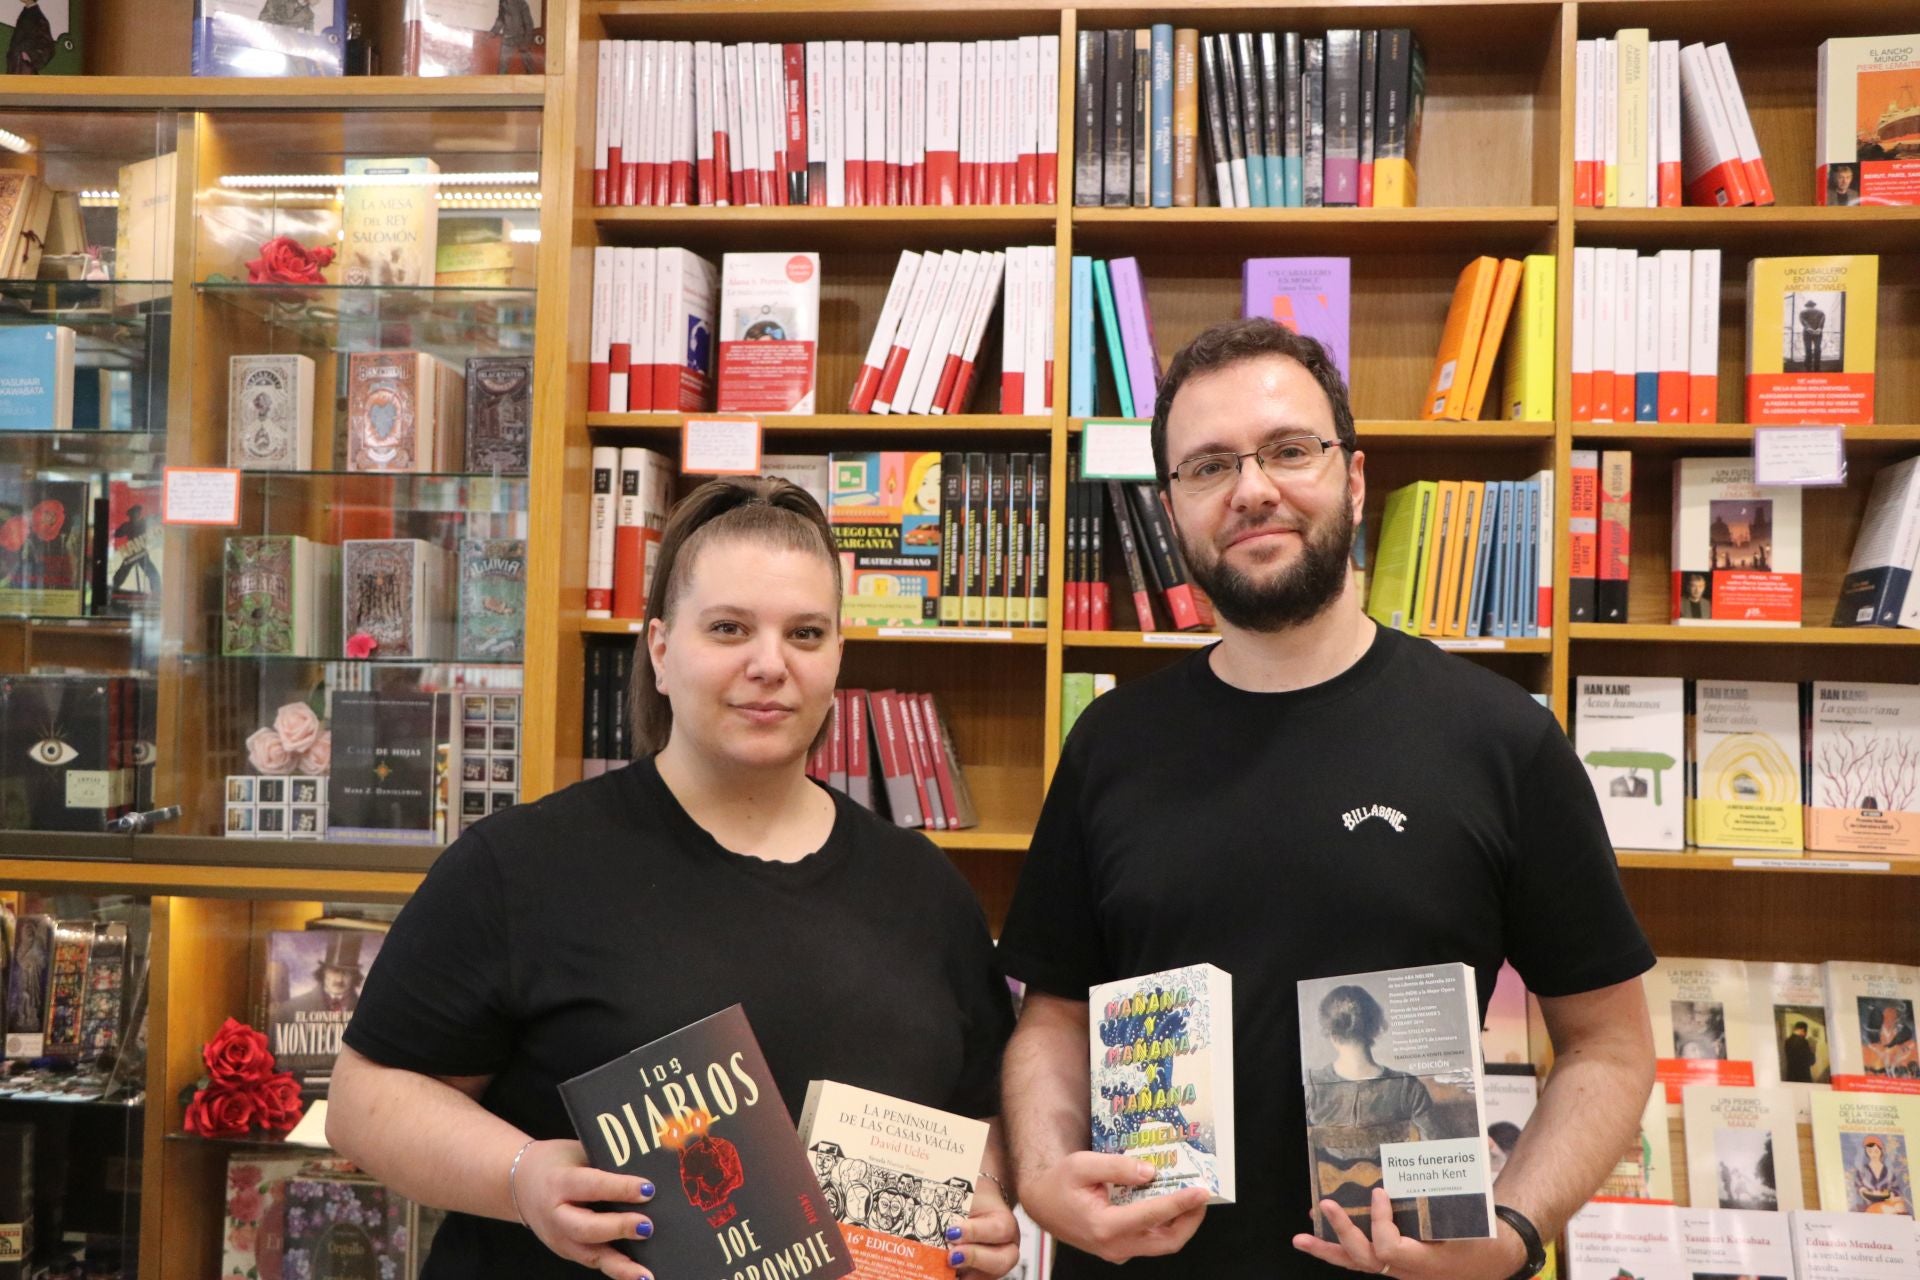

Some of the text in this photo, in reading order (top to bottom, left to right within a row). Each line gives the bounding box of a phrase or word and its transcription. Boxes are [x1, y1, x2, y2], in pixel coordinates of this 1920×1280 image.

[1882, 47, 1913, 56] ANCHO
[379, 199, 413, 209] MESA
[386, 215, 408, 226] REY
[352, 229, 417, 243] SALOMÓN
[1784, 267, 1848, 275] UN CABALLERO
[1572, 475, 1582, 512] DAMASCO
[869, 527, 882, 538] EN
[884, 528, 899, 538] LA
[836, 539, 894, 549] GARGANTA
[860, 558, 931, 566] BEATRIZ SERRANO
[1584, 684, 1631, 696] HAN KANG
[1703, 687, 1748, 700] HAN KANG
[1820, 689, 1840, 700] HAN
[1584, 698, 1660, 709] Actos humanos
[1820, 703, 1900, 716] La vegetariana
[881, 697, 895, 741] VARGAS LLOSA
[1703, 714, 1727, 724] decir
[1342, 804, 1408, 832] BILLABONG
[1104, 986, 1196, 1020] MAÑANA,
[295, 1011, 306, 1022] EL
[309, 1011, 340, 1022] CONDE
[1144, 1015, 1156, 1036] Y
[275, 1022, 348, 1055] MONTECR
[1104, 1037, 1198, 1068] MAÑANA,
[1418, 1060, 1450, 1070] EDICIÓN
[1145, 1062, 1158, 1083] Y
[1110, 1083, 1197, 1115] MAÑANA
[1718, 1098, 1731, 1106] UN
[596, 1052, 759, 1167] DIABLOS
[1710, 1105, 1723, 1113] DE
[1840, 1104, 1899, 1113] LOS MISTERIOS
[863, 1103, 948, 1135] LA PENÍNSULA
[1845, 1117, 1895, 1127] KAMOGAWA
[1862, 1112, 1900, 1120] TABERNA
[839, 1112, 965, 1155] DE LAS CASAS VACÍAS
[1108, 1121, 1200, 1150] GABRIELLE
[870, 1135, 930, 1161] David Uclés
[1388, 1152, 1475, 1168] Ritos funerarios
[1398, 1169, 1467, 1182] Hannah Kent
[717, 1218, 762, 1265] JOE
[1574, 1230, 1614, 1242] Santiago
[1684, 1234, 1770, 1246] Yasunari Kawabata
[328, 1244, 365, 1254] Orgullo
[865, 1236, 916, 1258] EDICIÓN
[1805, 1238, 1893, 1251] Eduardo Mendoza
[1807, 1251, 1817, 1260] La
[1819, 1252, 1849, 1261] verdad
[1850, 1254, 1873, 1263] sobre
[1875, 1255, 1883, 1263] el
[1808, 1263, 1839, 1272] Savolta
